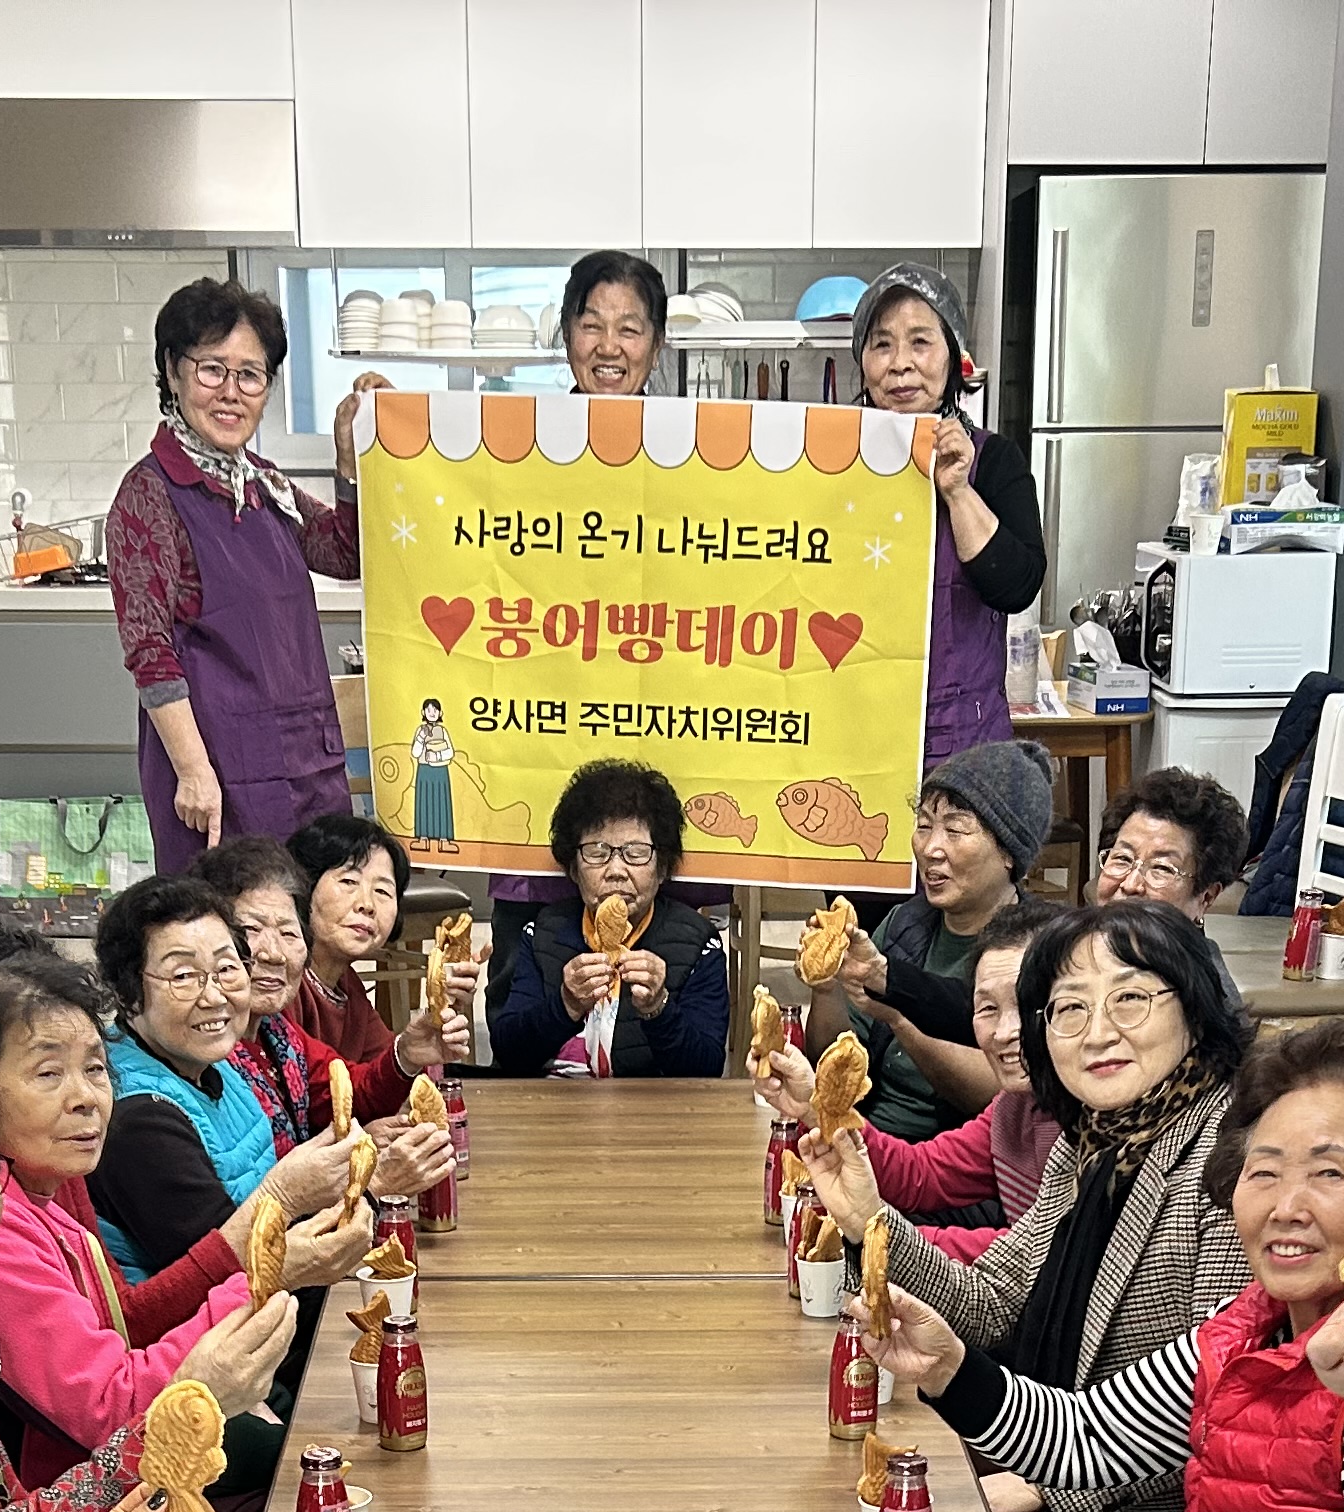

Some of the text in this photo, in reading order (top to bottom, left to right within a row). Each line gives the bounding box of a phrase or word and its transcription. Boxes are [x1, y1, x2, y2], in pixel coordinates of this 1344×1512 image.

[1254, 407, 1299, 421] Maxim
[1239, 513, 1259, 522] NH
[454, 509, 833, 565] 사랑의 온기 나눠드려요
[480, 596, 798, 672] 붕어빵데이
[469, 696, 810, 746] 양사면 주민자치위원회
[1106, 703, 1125, 712] NH
